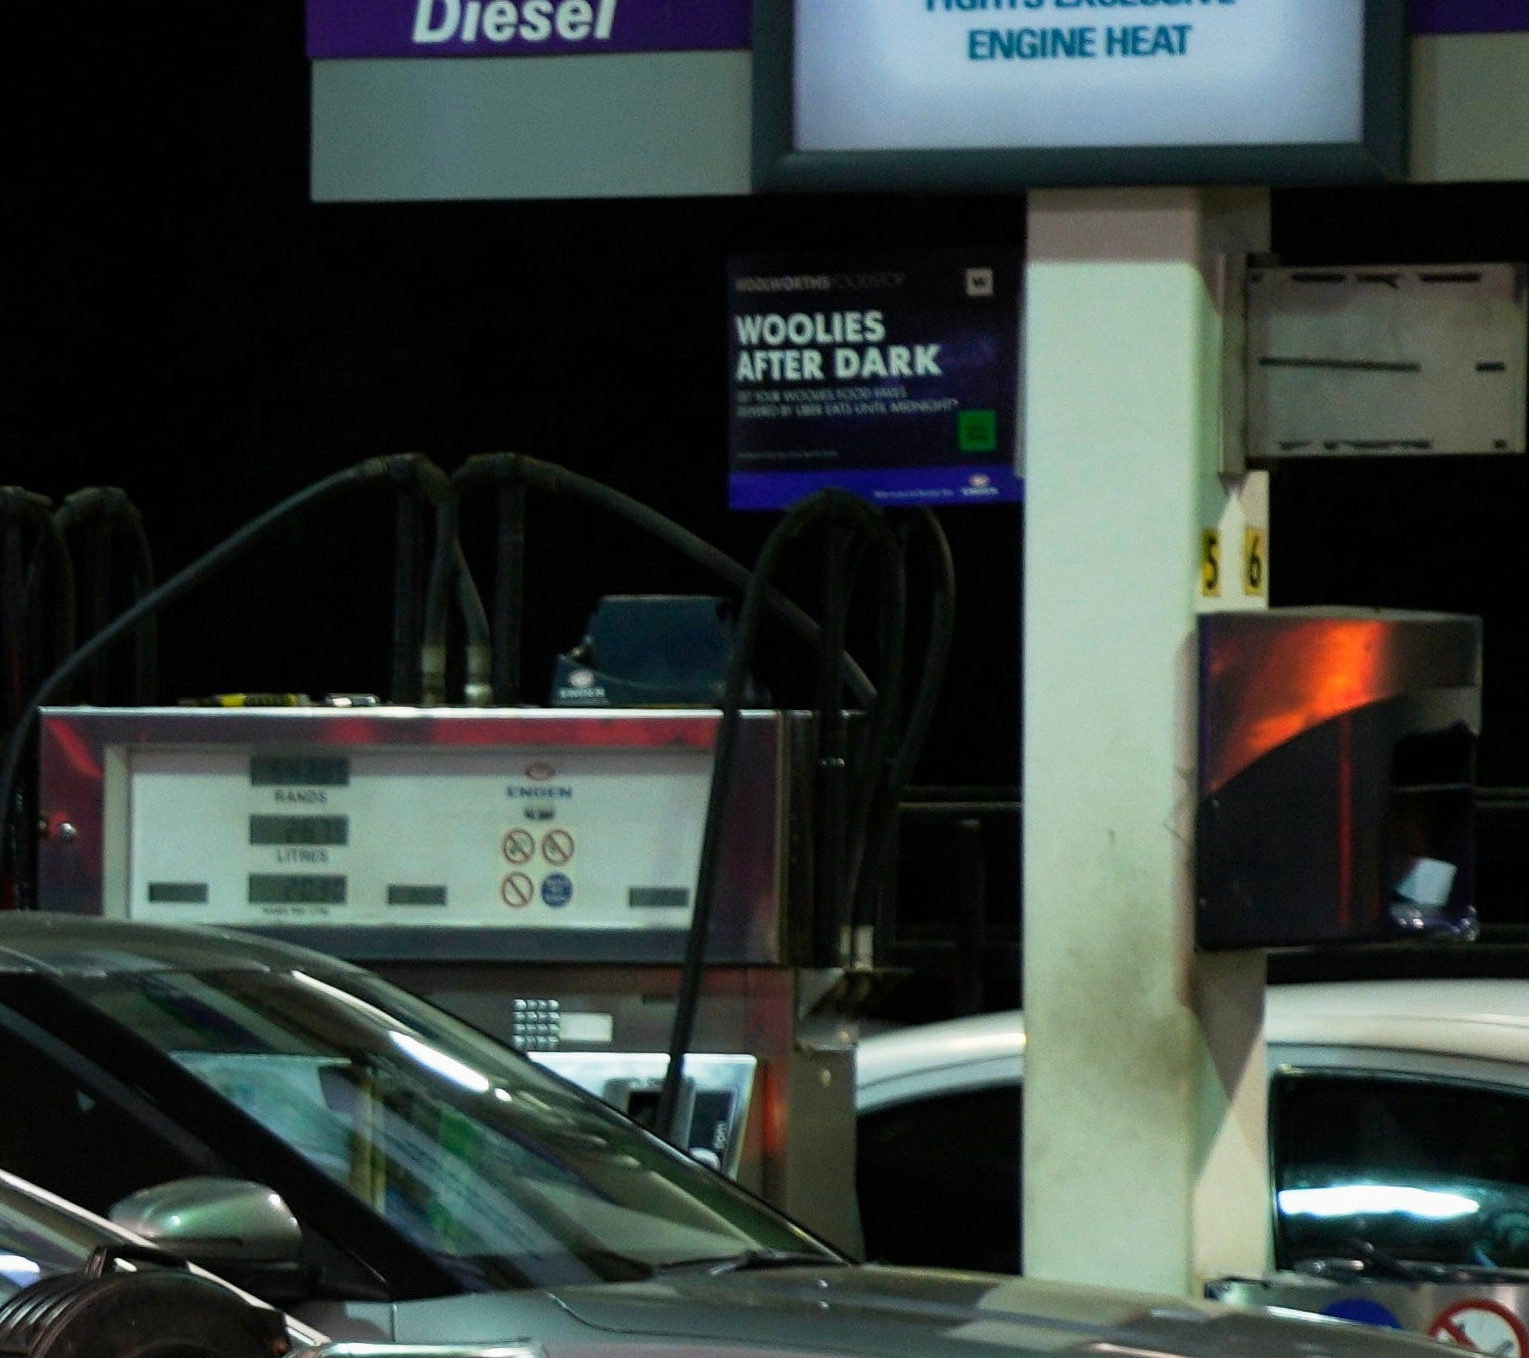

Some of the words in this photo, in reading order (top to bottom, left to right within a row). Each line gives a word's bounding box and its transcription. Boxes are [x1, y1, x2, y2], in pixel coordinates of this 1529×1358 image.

[967, 28, 1093, 63] ENGINE
[1103, 24, 1193, 59] HEAT
[734, 309, 887, 345] WOOLIES
[735, 347, 825, 382] AFTER
[834, 343, 943, 380] DARK
[1207, 535, 1219, 591] 5
[1248, 532, 1262, 589] 6
[274, 790, 328, 804] RANDS
